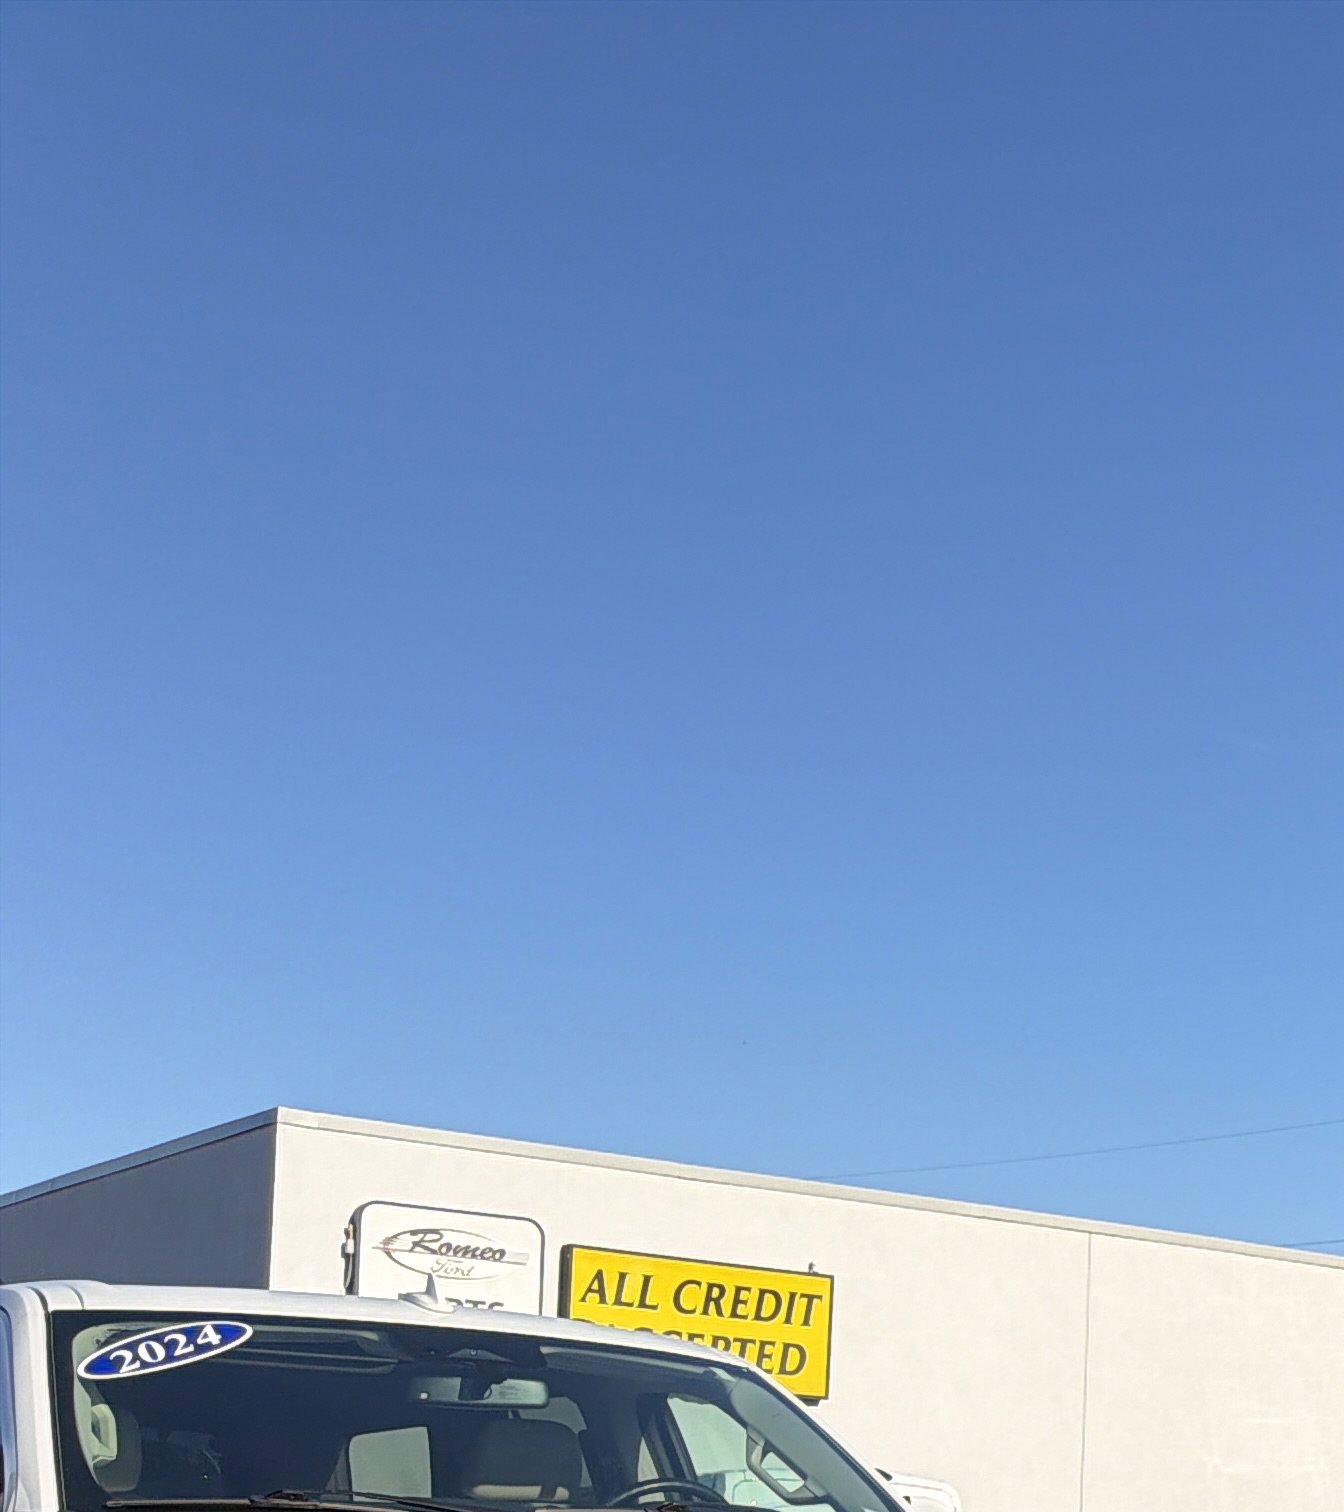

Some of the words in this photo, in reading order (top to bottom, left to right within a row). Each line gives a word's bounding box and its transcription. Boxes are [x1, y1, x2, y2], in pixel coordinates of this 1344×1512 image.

[409, 1229, 507, 1262] Romeo
[430, 1258, 475, 1277] Ford
[578, 1268, 659, 1311] ALL
[672, 1279, 823, 1328] CREDIT
[109, 1323, 223, 1375] 2024
